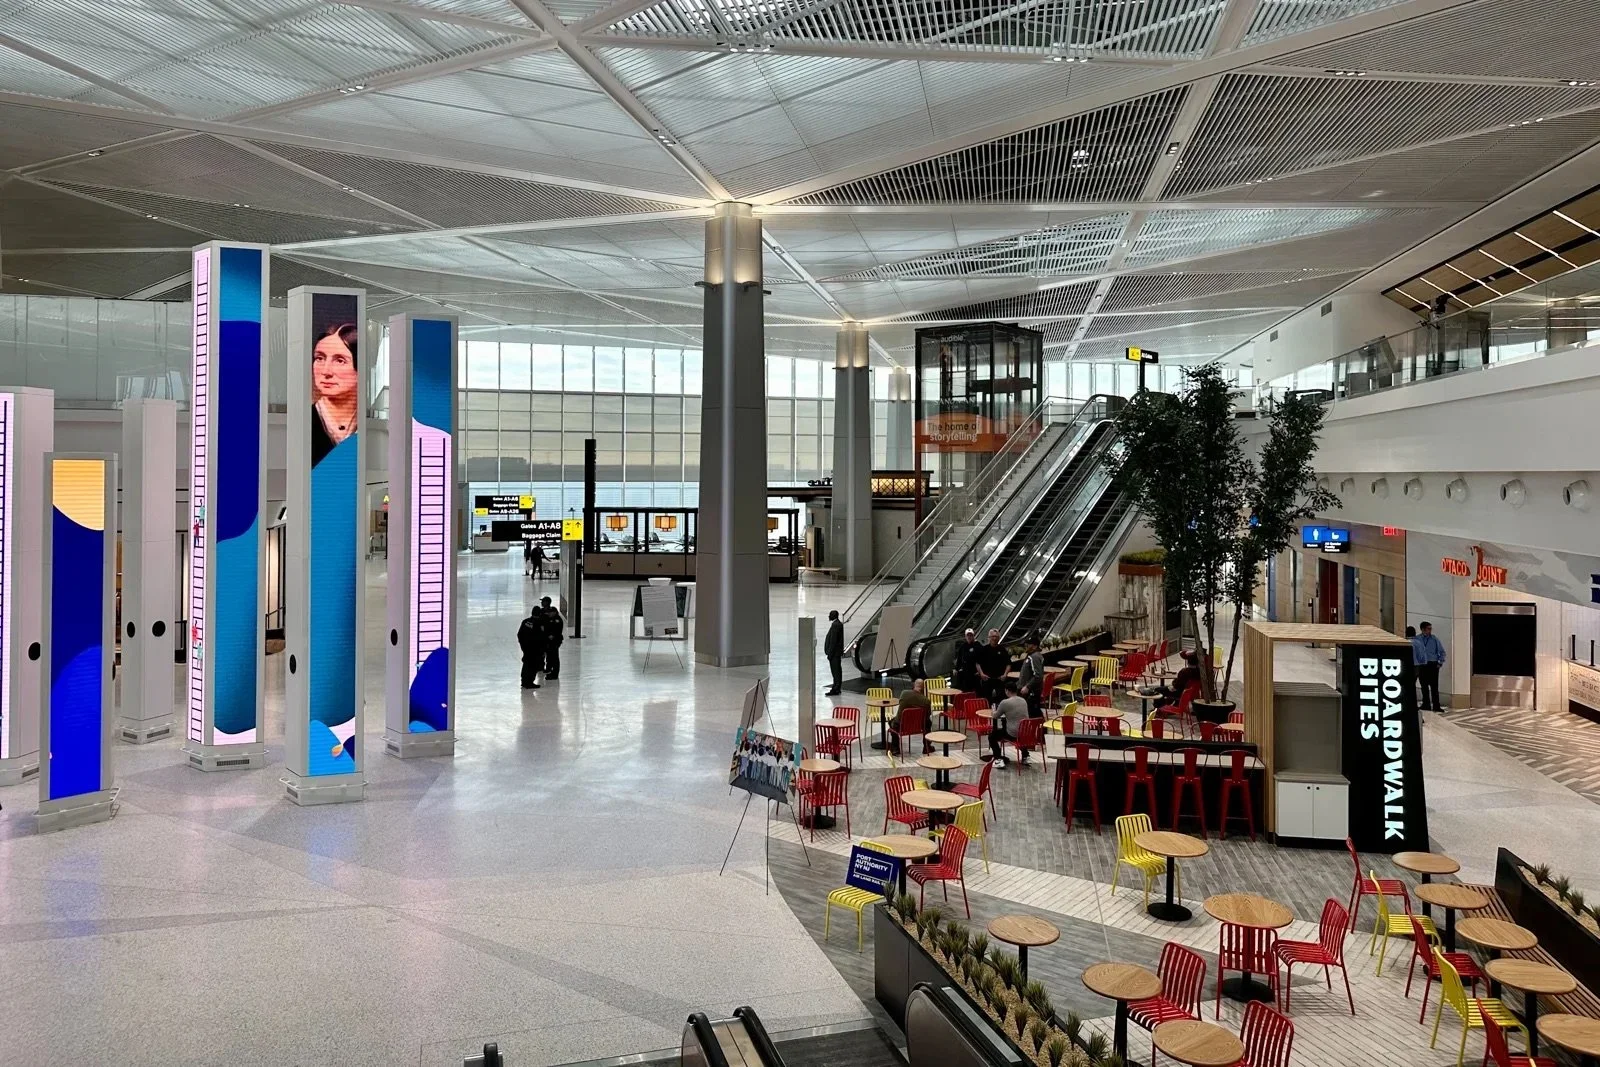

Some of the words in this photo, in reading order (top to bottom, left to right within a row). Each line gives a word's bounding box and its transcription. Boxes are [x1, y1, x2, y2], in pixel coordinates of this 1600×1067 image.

[941, 334, 964, 342] audible
[927, 422, 943, 431] The
[944, 422, 969, 431] home
[929, 431, 978, 443] storytelling
[1477, 565, 1503, 584] JOINT
[1359, 658, 1380, 739] BITES
[1381, 658, 1404, 840] BOARDWALK
[856, 854, 872, 862] PORT
[856, 858, 888, 872] AUTHORITY
